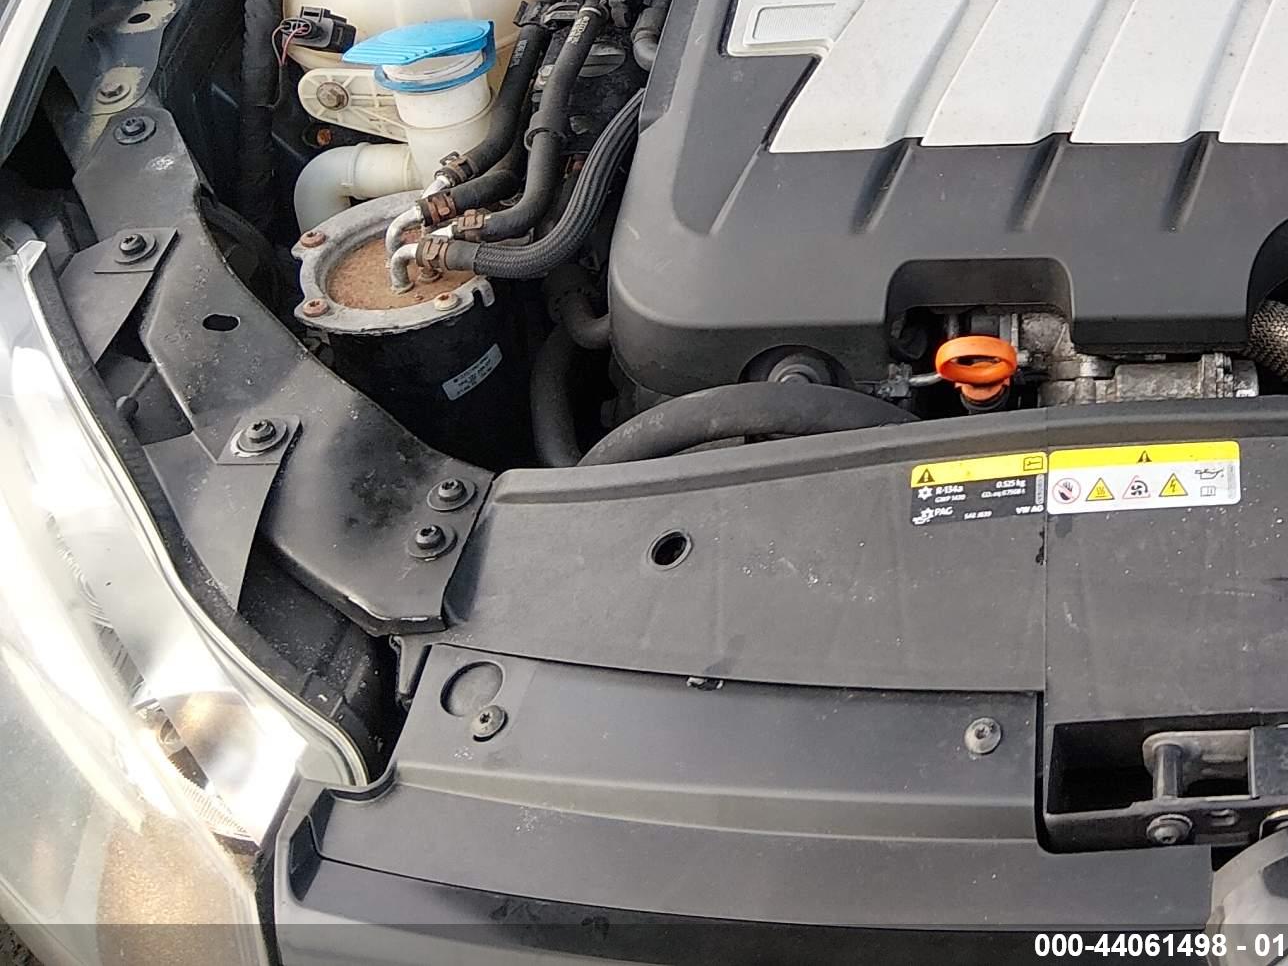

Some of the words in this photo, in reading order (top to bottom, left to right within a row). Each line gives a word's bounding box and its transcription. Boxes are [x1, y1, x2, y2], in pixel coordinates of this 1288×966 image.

[936, 485, 964, 494] R-134a
[935, 506, 953, 516] PAG
[1015, 506, 1030, 514] VW
[1031, 504, 1044, 513] AG
